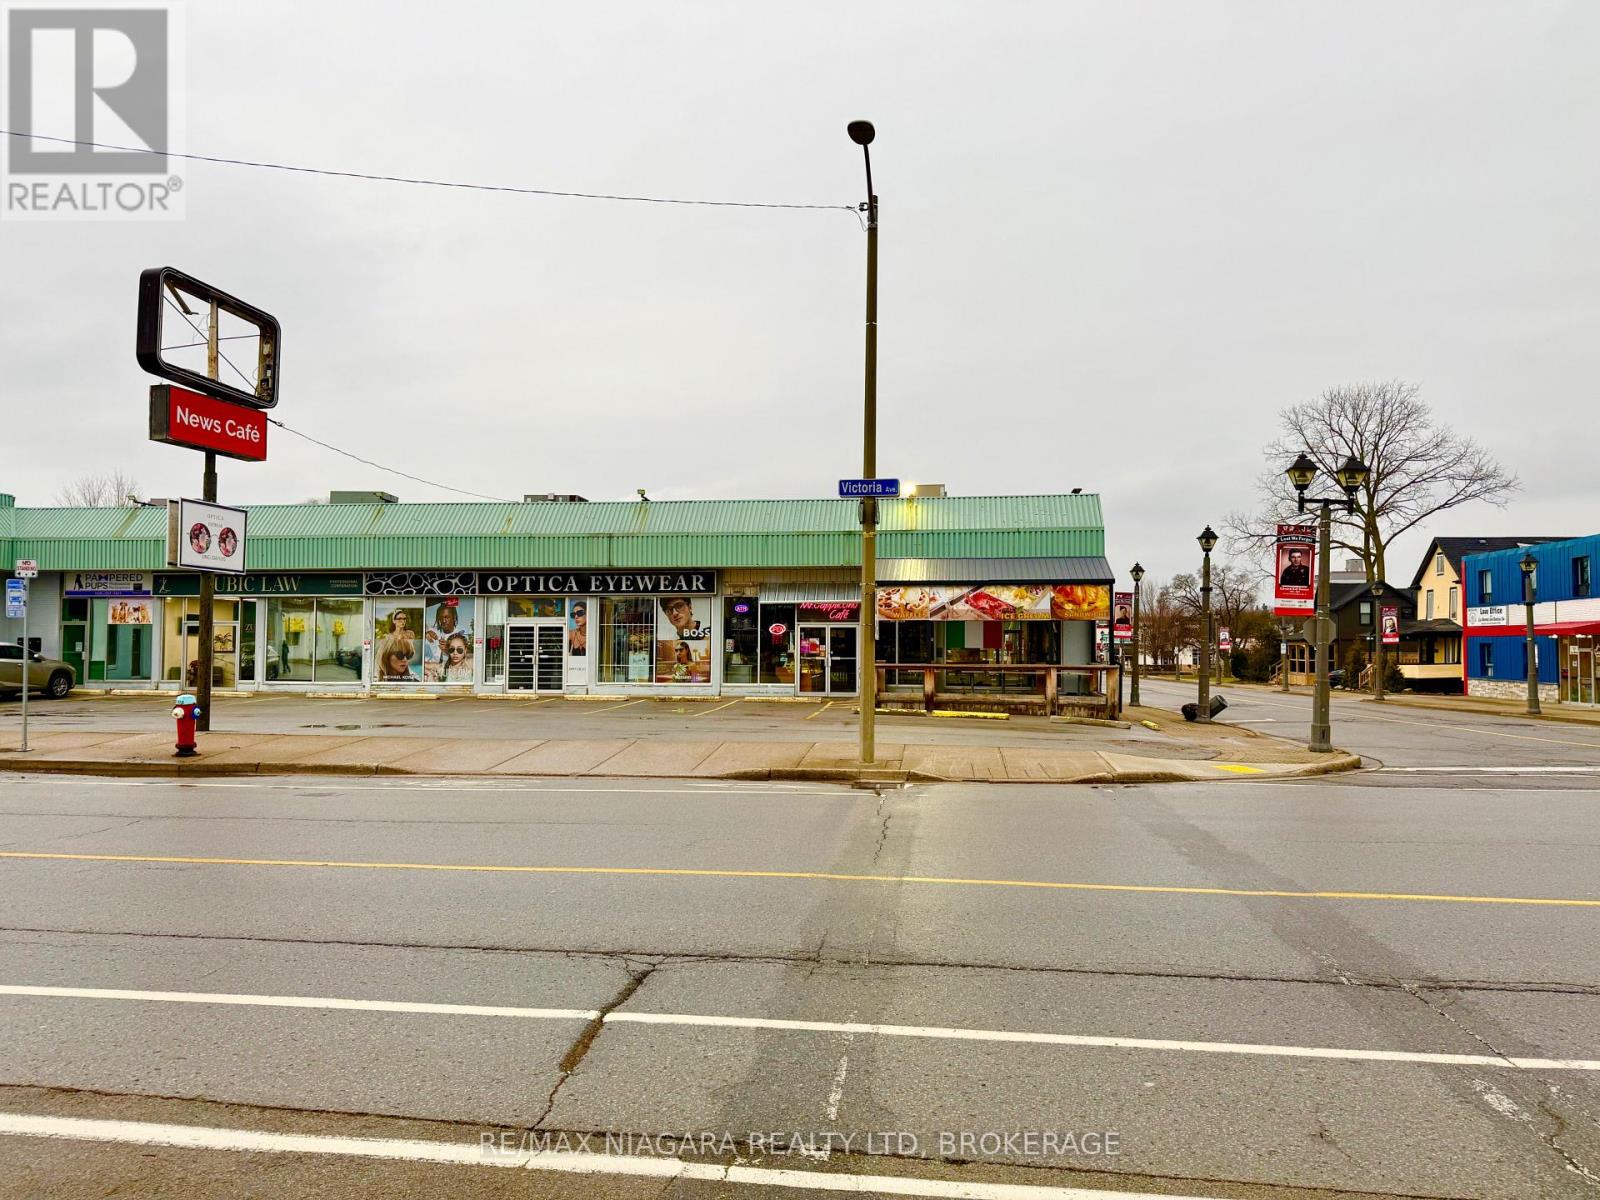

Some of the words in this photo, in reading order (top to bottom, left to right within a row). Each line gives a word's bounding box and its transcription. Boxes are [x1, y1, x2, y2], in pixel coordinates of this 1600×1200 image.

[176, 405, 221, 433] News
[225, 420, 261, 442] Café
[841, 481, 882, 493] Victoria
[85, 581, 108, 590] PUPS
[213, 576, 255, 592] UBIC
[260, 575, 300, 592] LAW
[486, 575, 579, 592] OPTICA
[590, 574, 706, 592] EYEWEAR
[829, 609, 850, 620] Café
[683, 629, 711, 637] BOSS
